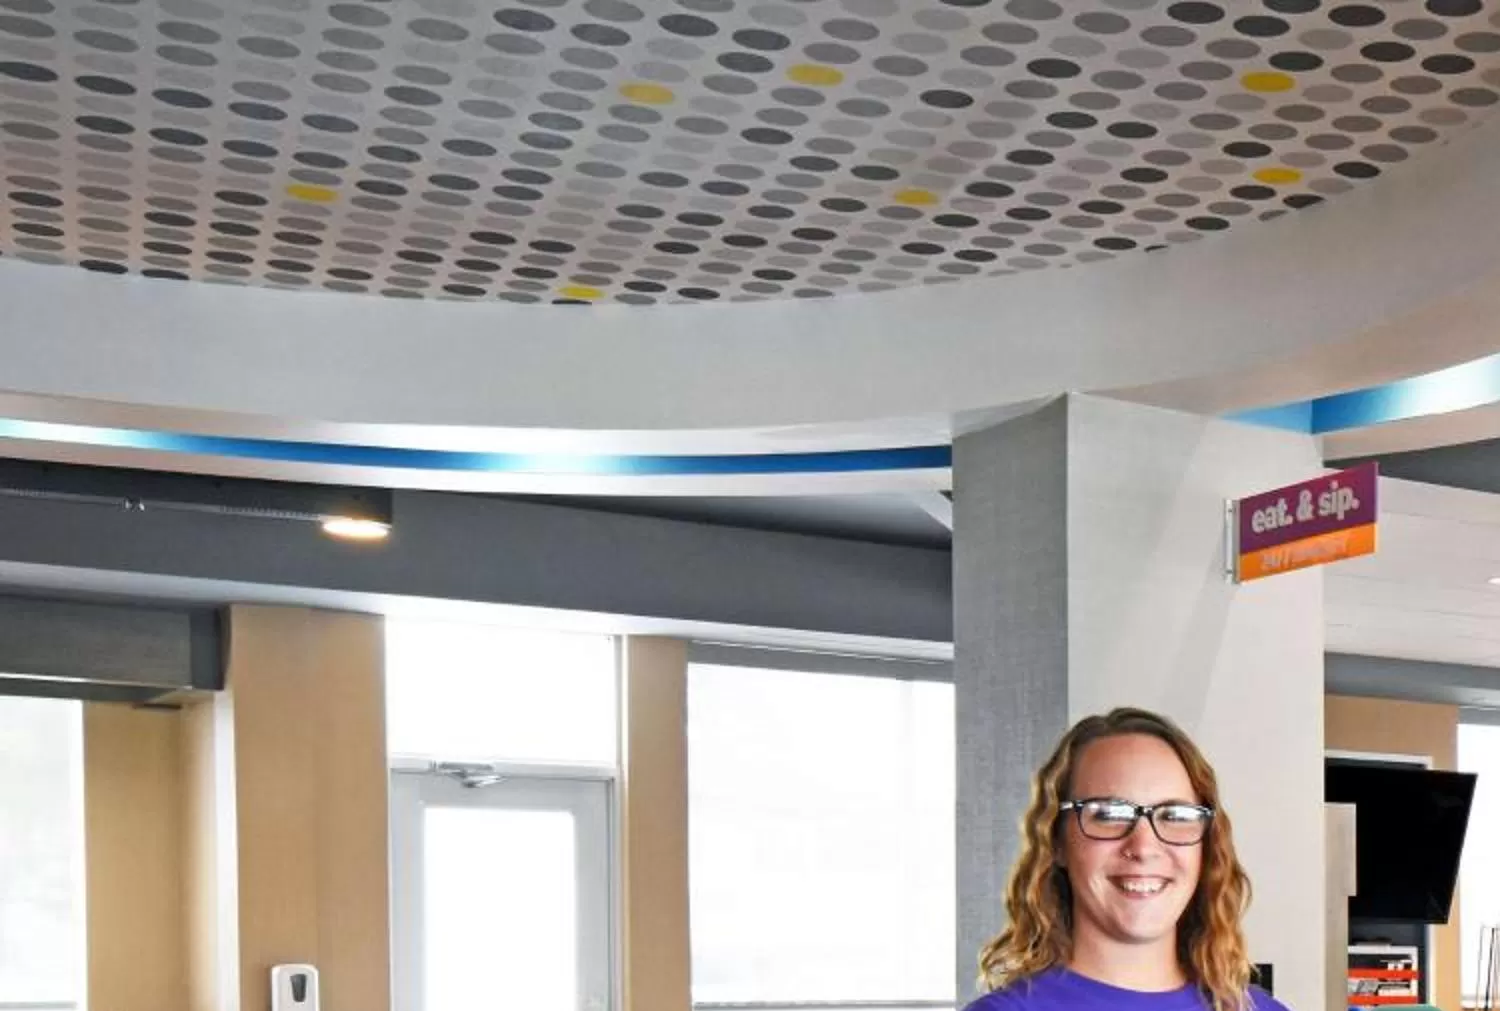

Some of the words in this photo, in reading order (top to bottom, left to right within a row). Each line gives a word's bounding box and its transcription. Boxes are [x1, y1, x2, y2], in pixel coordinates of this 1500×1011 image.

[1252, 497, 1293, 533] eat.
[1296, 489, 1314, 521] &
[1318, 479, 1360, 520] sip.
